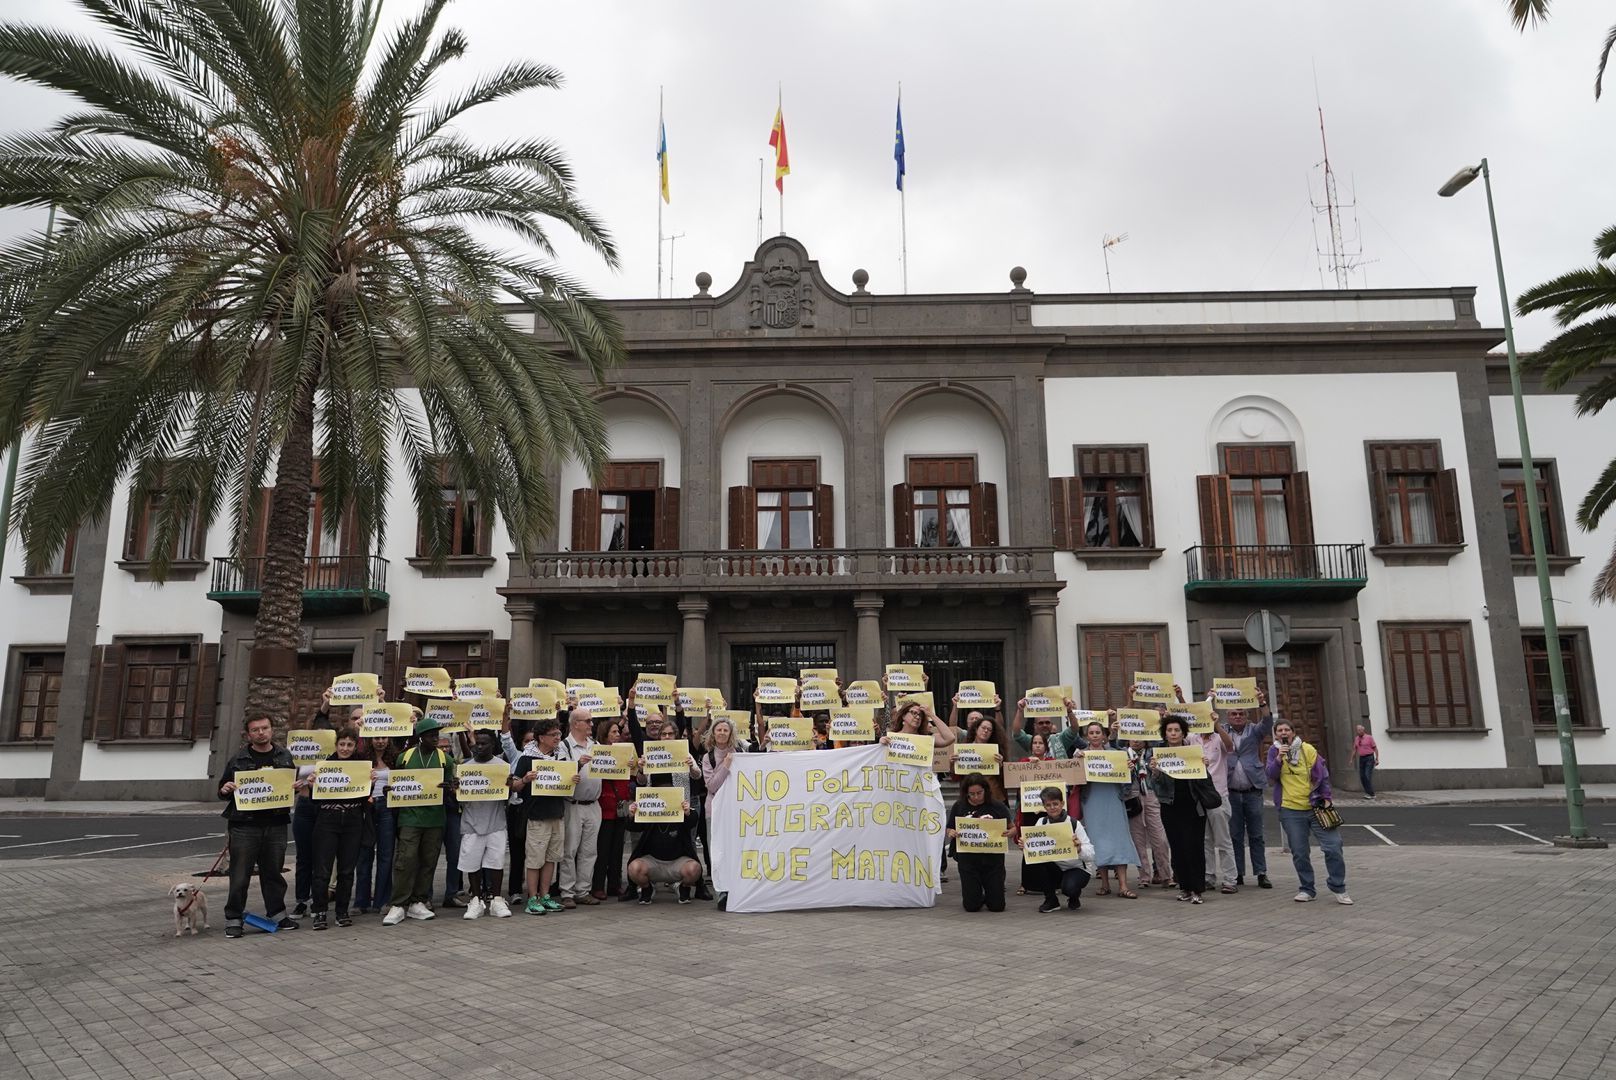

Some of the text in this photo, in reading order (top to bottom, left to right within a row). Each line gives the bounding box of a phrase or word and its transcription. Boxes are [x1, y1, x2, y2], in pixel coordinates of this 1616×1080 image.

[251, 795, 289, 804] ENEMIGAS
[737, 770, 790, 801] NO
[739, 802, 942, 837] MIGRATORIAS
[740, 845, 934, 888] QUE MATAN
